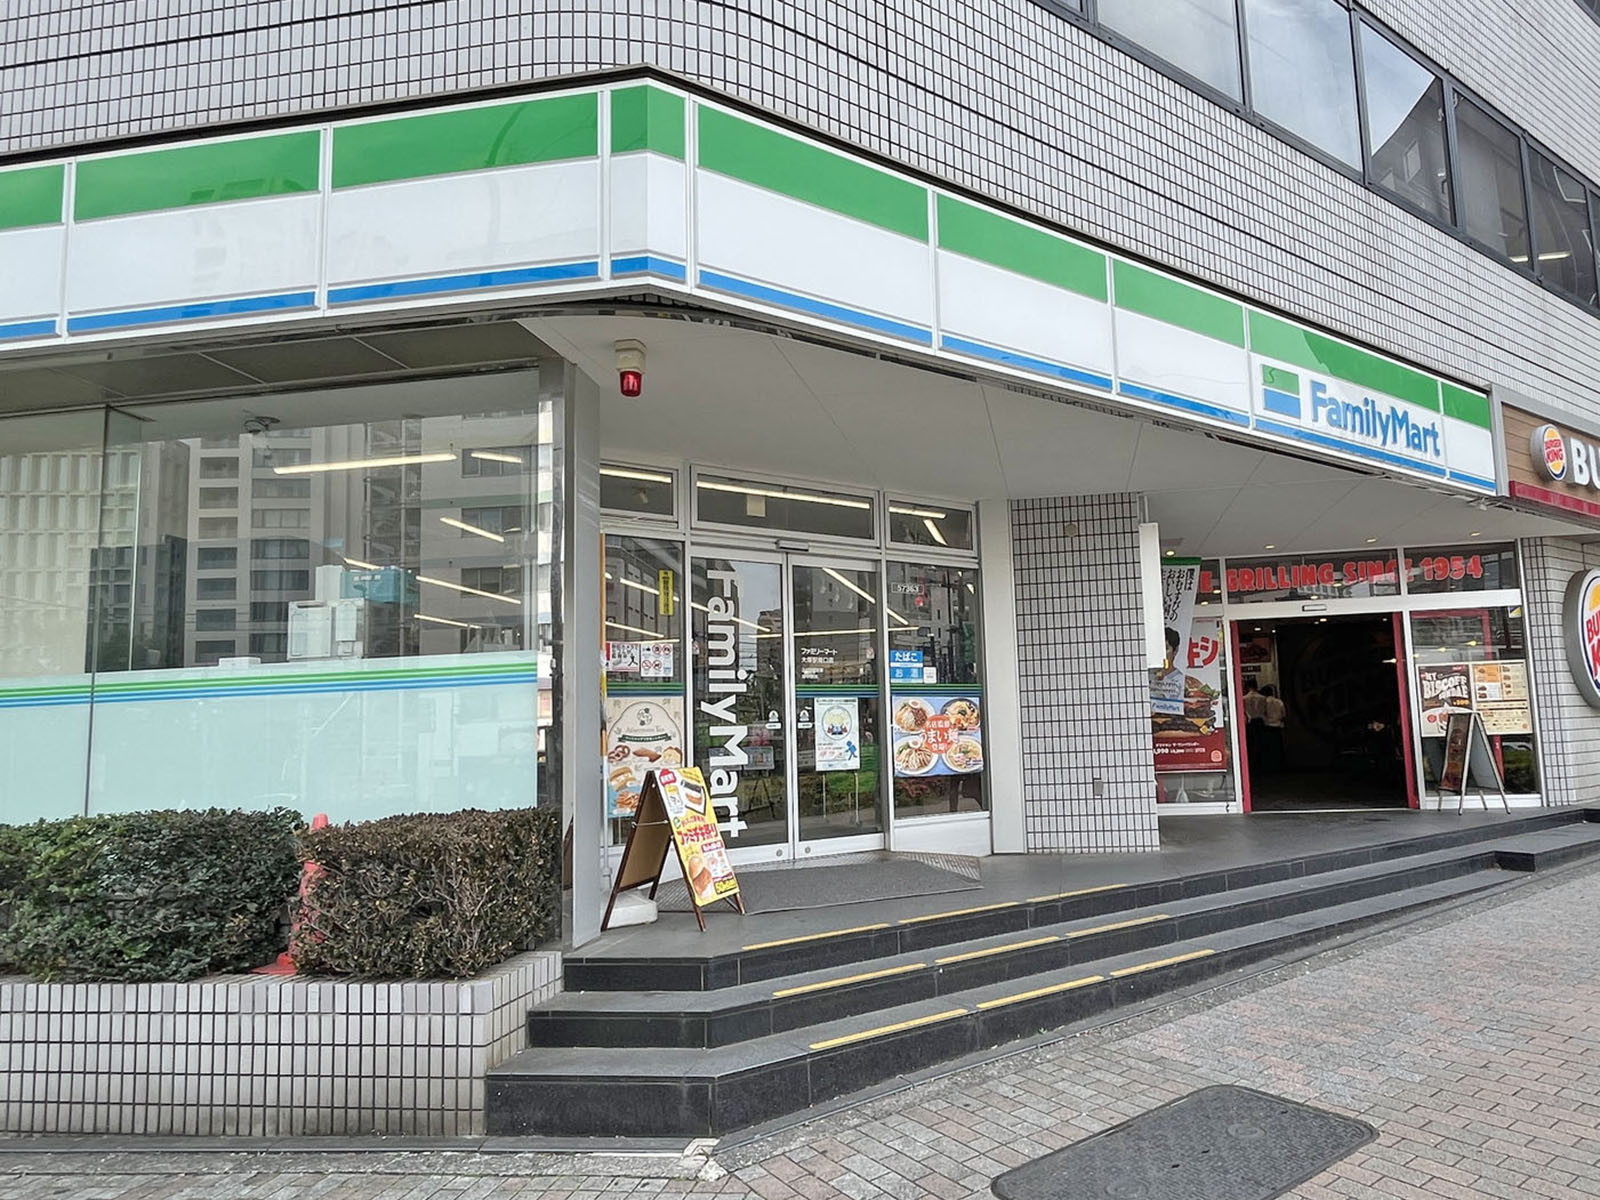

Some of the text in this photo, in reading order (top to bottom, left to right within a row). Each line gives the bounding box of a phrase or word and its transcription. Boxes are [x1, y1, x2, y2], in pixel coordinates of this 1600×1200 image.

[1310, 379, 1440, 457] FamilyMart
[1343, 557, 1412, 586] SINC
[1419, 555, 1483, 582] 1954
[1170, 568, 1186, 623] おむすびの
[801, 647, 838, 656] ファミリーマート
[895, 652, 918, 662] たばこ
[701, 570, 749, 838] FamilyMart
